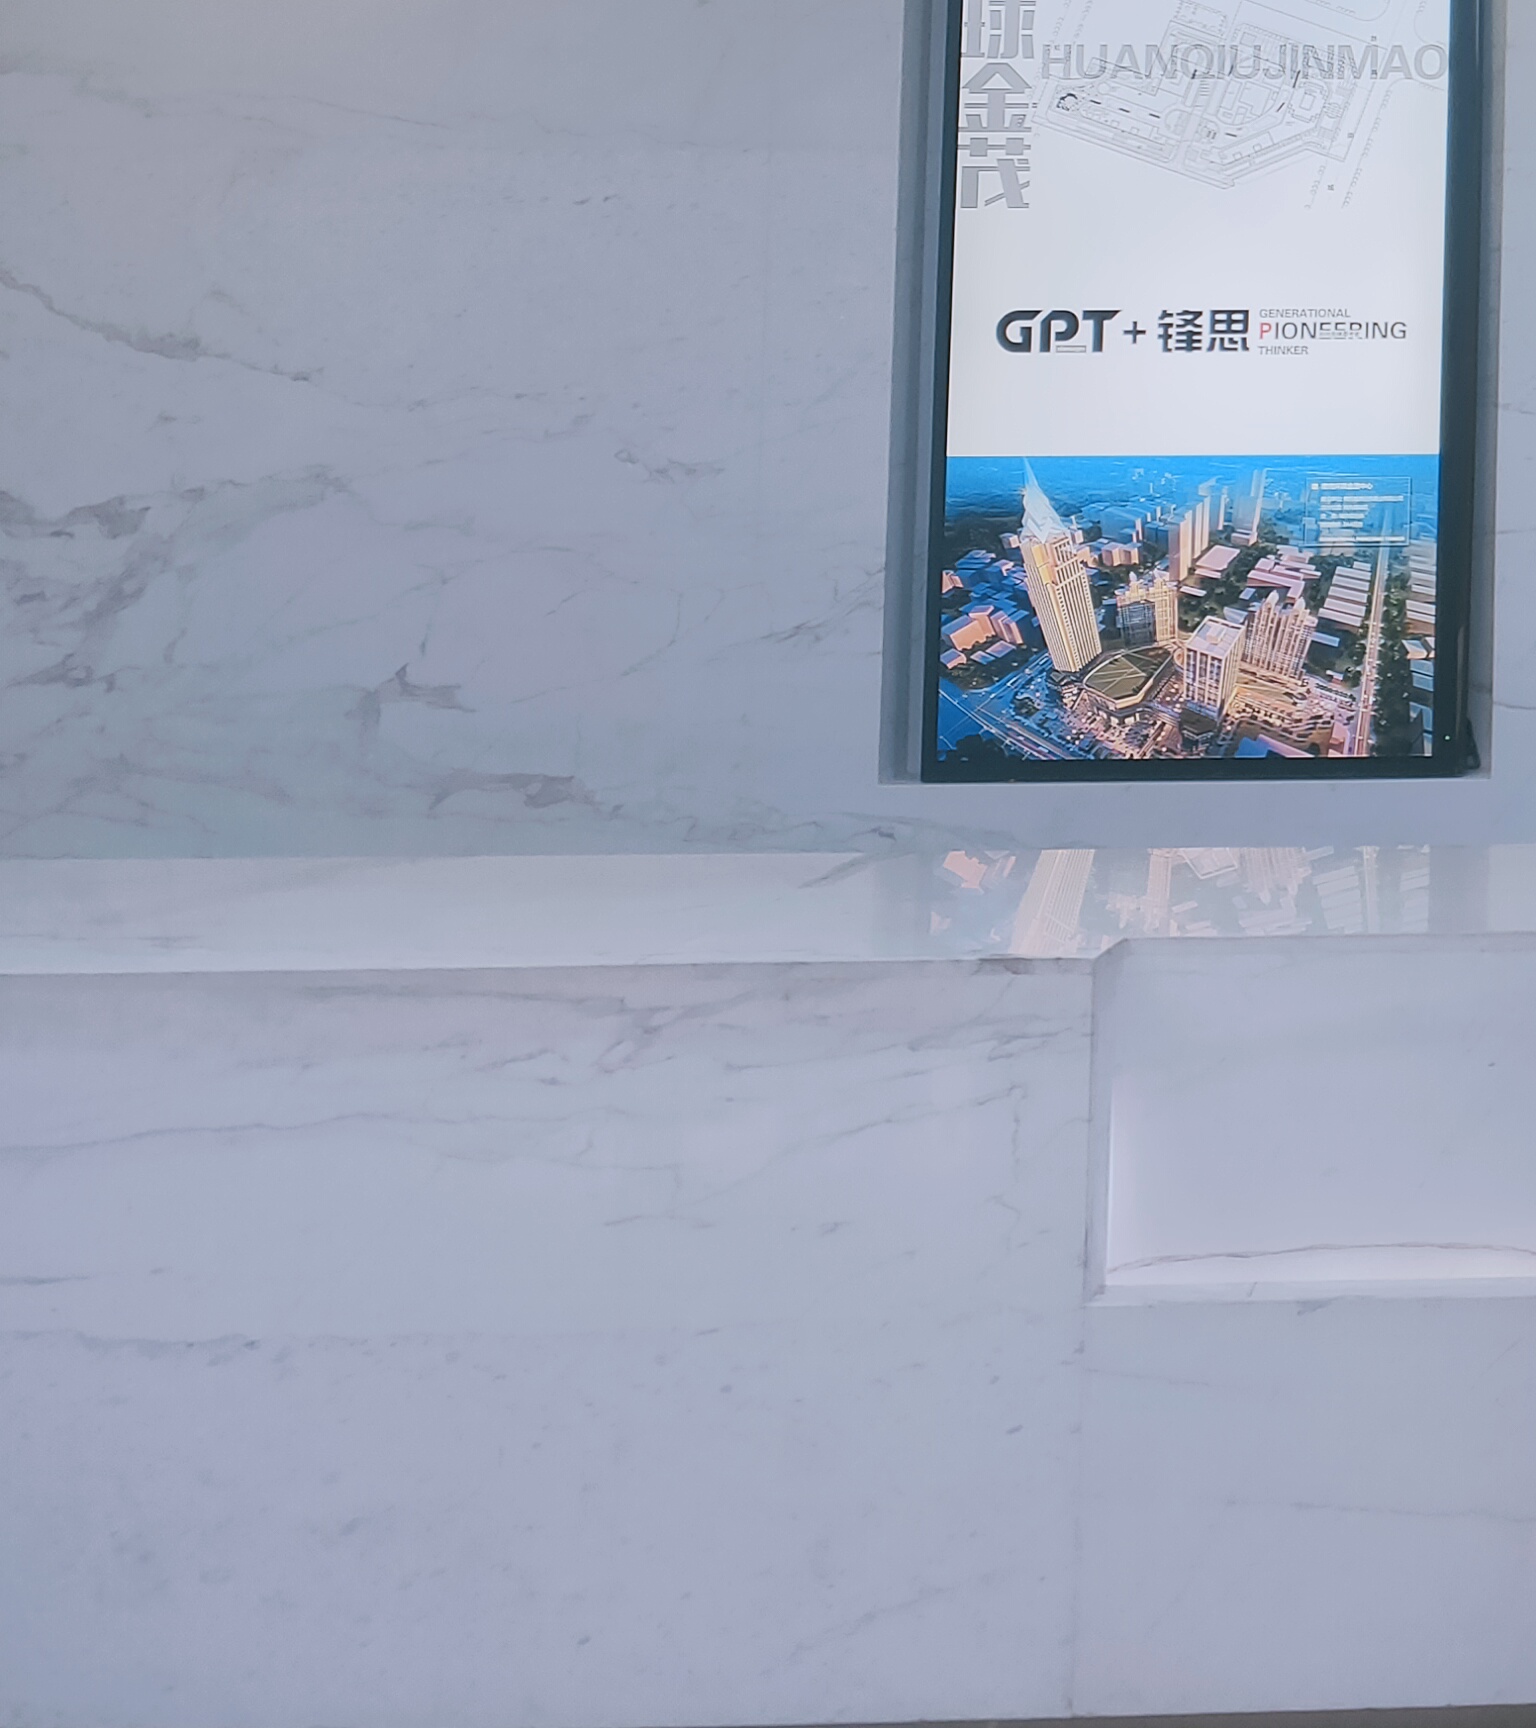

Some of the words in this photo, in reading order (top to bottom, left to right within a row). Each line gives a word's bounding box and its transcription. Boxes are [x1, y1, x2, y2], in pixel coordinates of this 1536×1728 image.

[1042, 44, 1447, 80] HUANQIUJINMAO
[1259, 308, 1351, 318] GENERATIONAL
[1259, 322, 1407, 340] PIONEERING
[1258, 345, 1309, 355] THINKER
